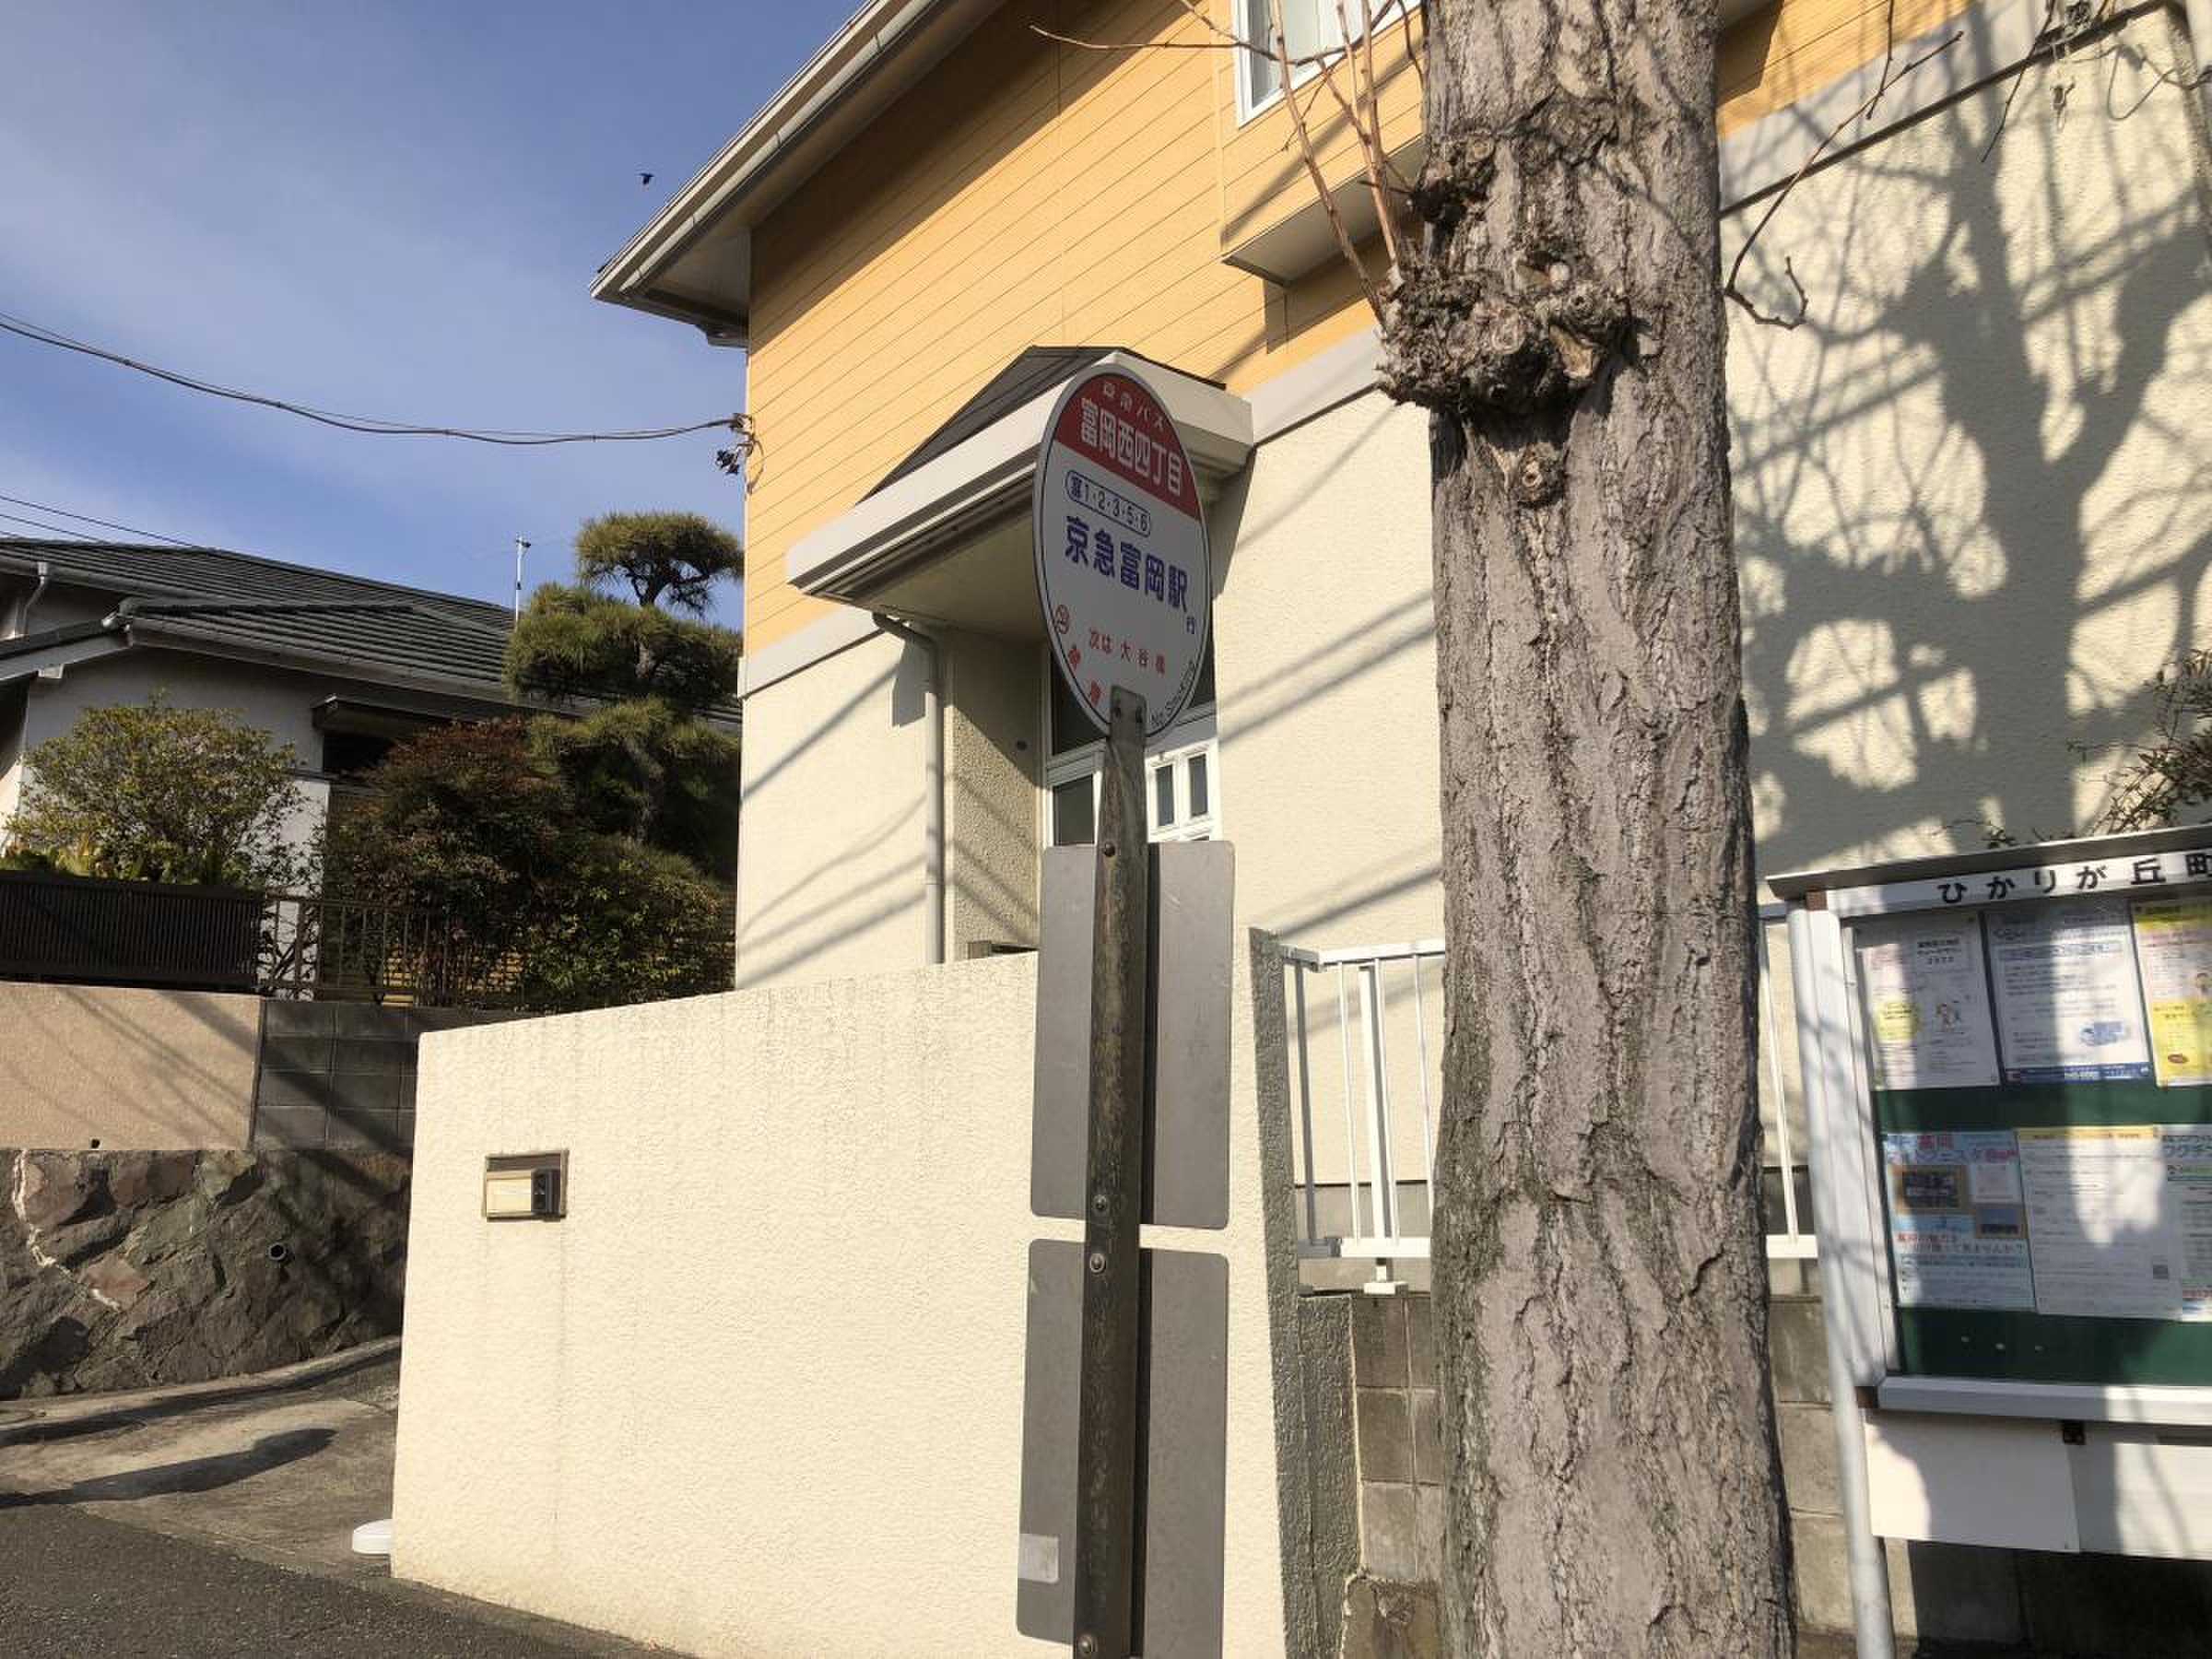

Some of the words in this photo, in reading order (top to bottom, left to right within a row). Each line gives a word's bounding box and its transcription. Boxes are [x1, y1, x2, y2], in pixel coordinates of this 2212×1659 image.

[1081, 397, 1182, 497] 富岡西四丁目
